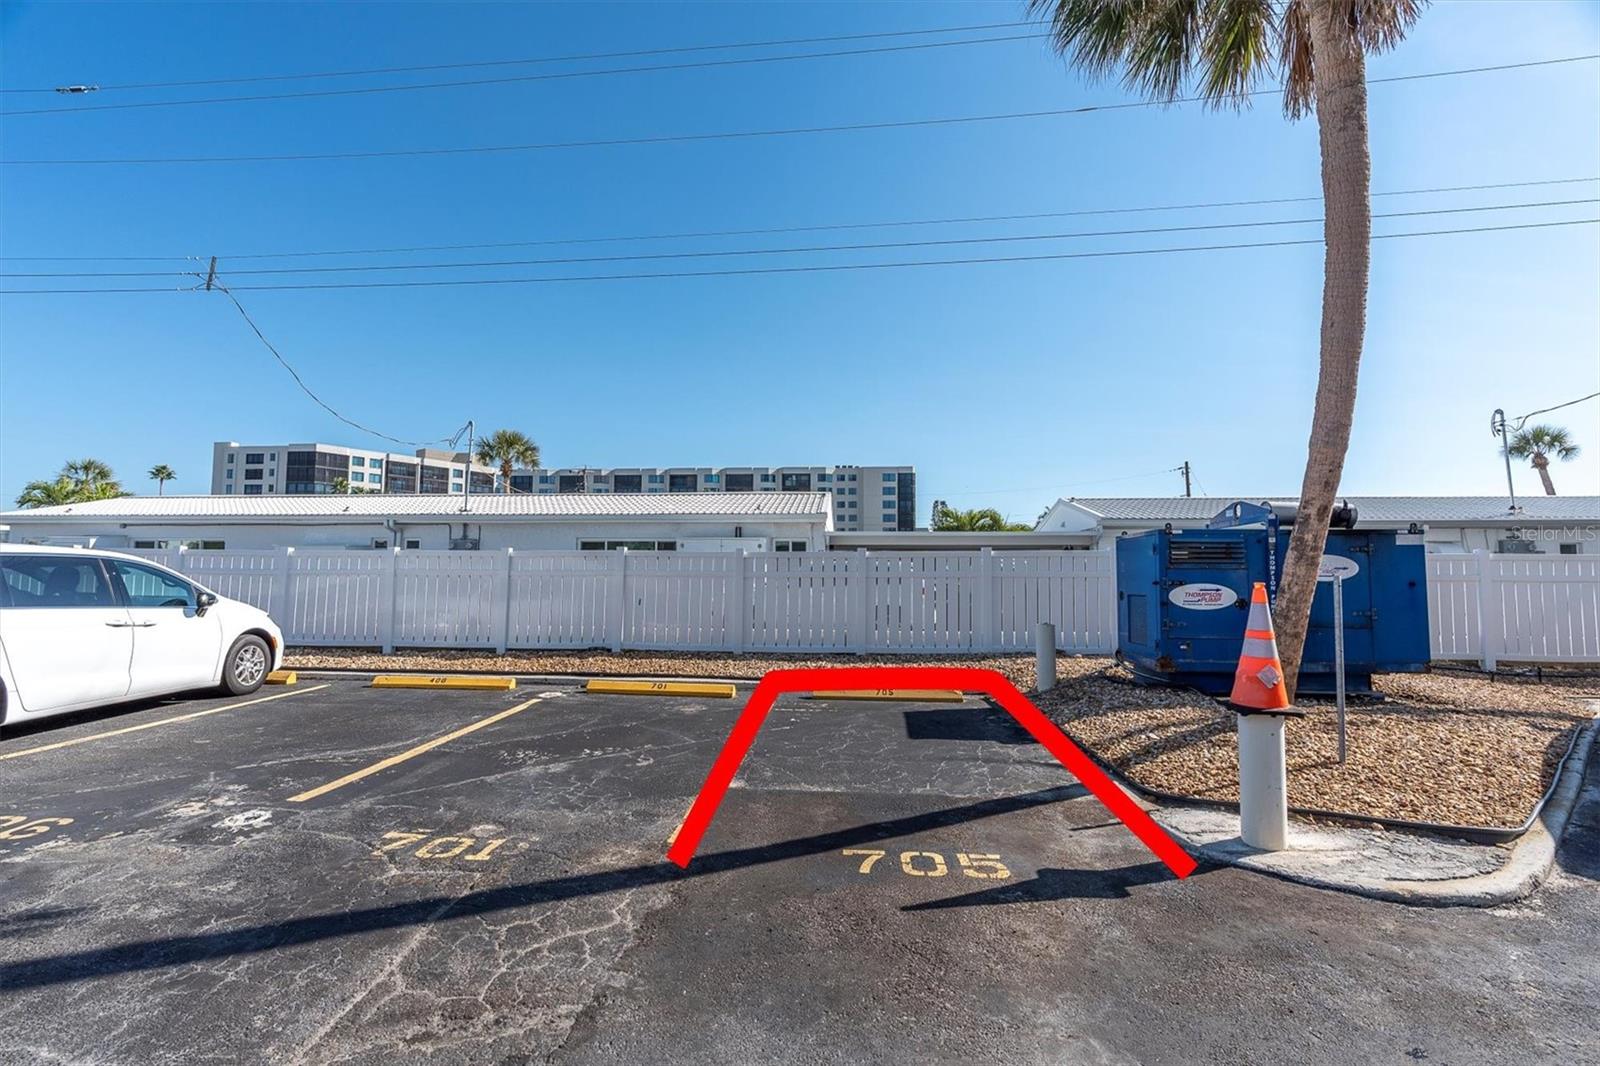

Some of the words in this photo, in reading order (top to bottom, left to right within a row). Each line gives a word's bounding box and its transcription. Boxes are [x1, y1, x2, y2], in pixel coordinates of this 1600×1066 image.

[876, 688, 895, 696] 705
[372, 830, 507, 861] 701
[842, 849, 1011, 880] 705
